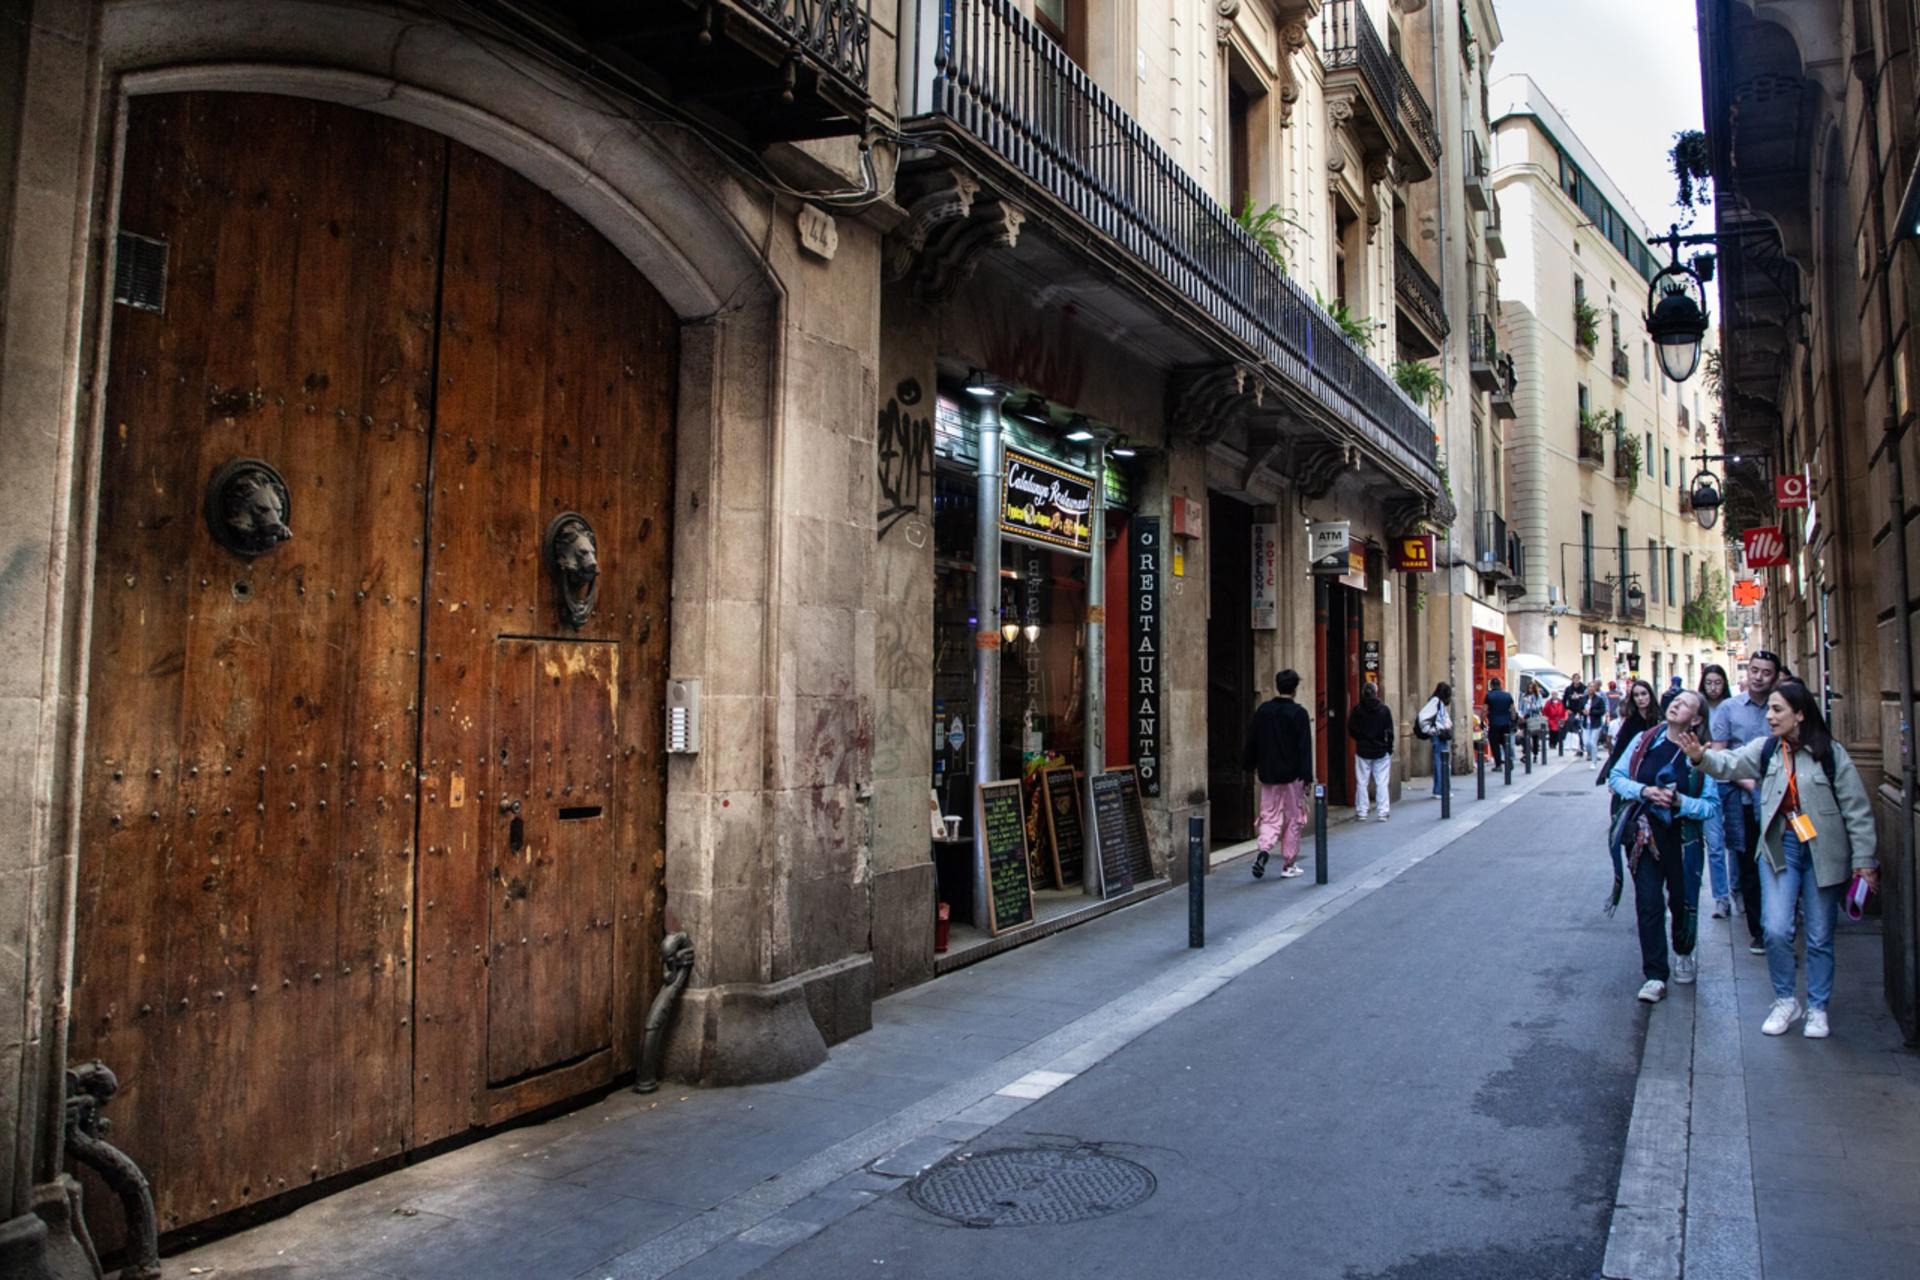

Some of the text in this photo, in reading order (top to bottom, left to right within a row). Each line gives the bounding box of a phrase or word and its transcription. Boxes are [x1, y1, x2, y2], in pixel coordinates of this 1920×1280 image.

[809, 215, 828, 247] 44
[1318, 531, 1342, 541] ATM
[1748, 533, 1784, 563] illy
[1255, 526, 1264, 598] BARCELONA
[1138, 553, 1155, 756] RESTAURANT
